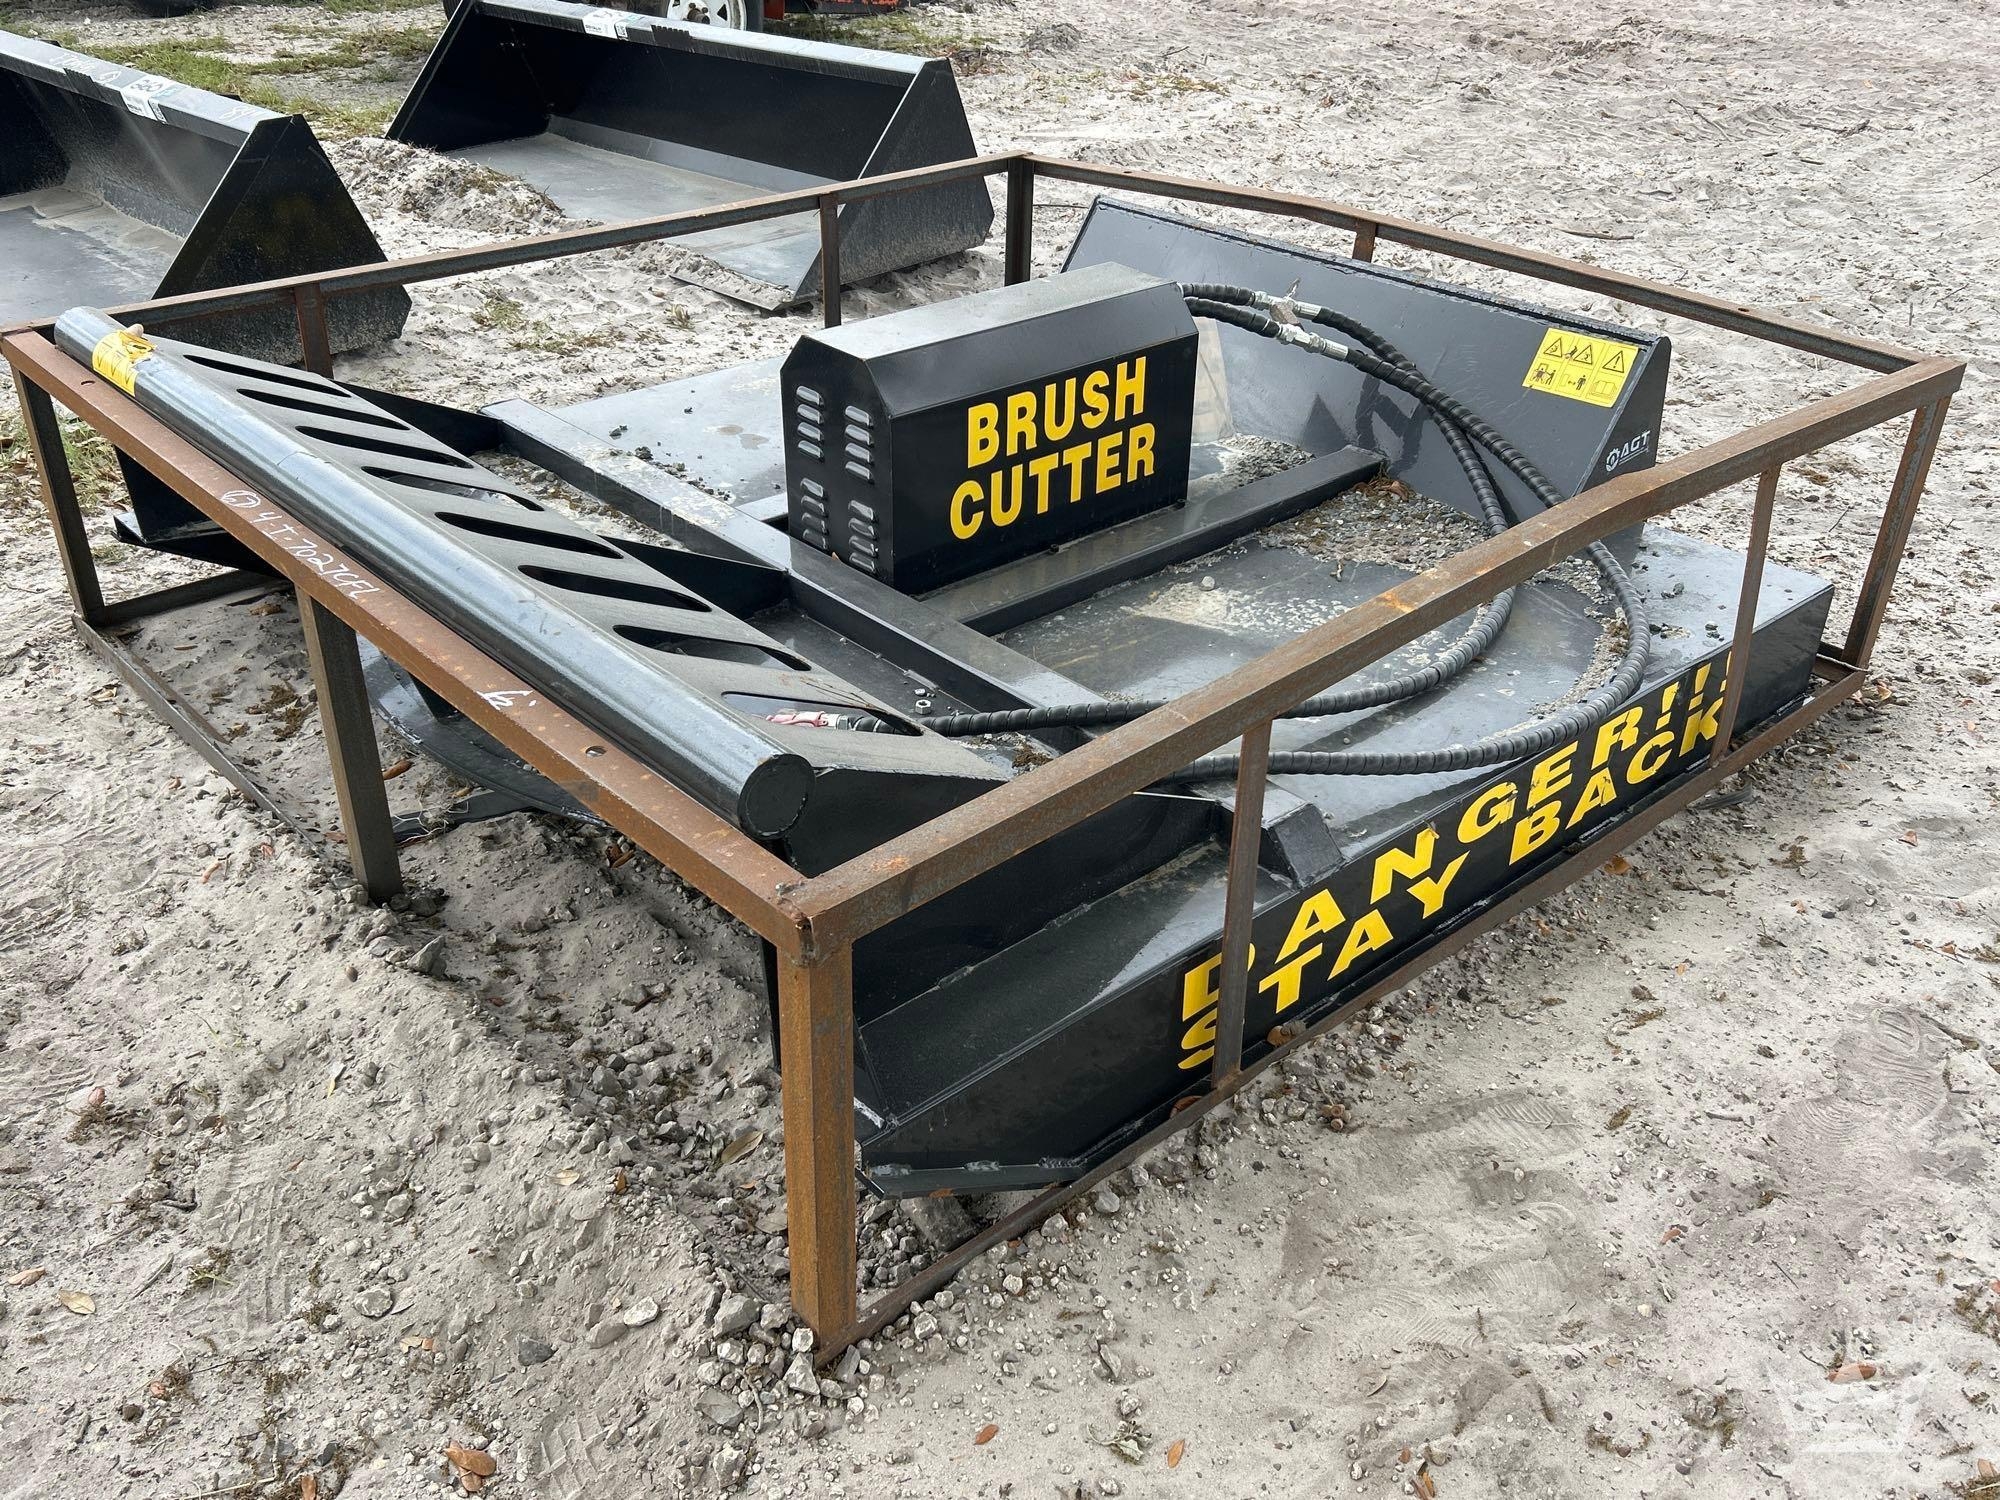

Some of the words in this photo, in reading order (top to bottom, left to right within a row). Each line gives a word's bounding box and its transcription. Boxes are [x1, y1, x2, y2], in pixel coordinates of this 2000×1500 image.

[967, 355, 1147, 469] BRUSH
[1620, 430, 1651, 459] AGT
[950, 422, 1156, 540] CUTTER
[1177, 850, 1471, 1070] STAY
[1508, 696, 1724, 867] BACK
